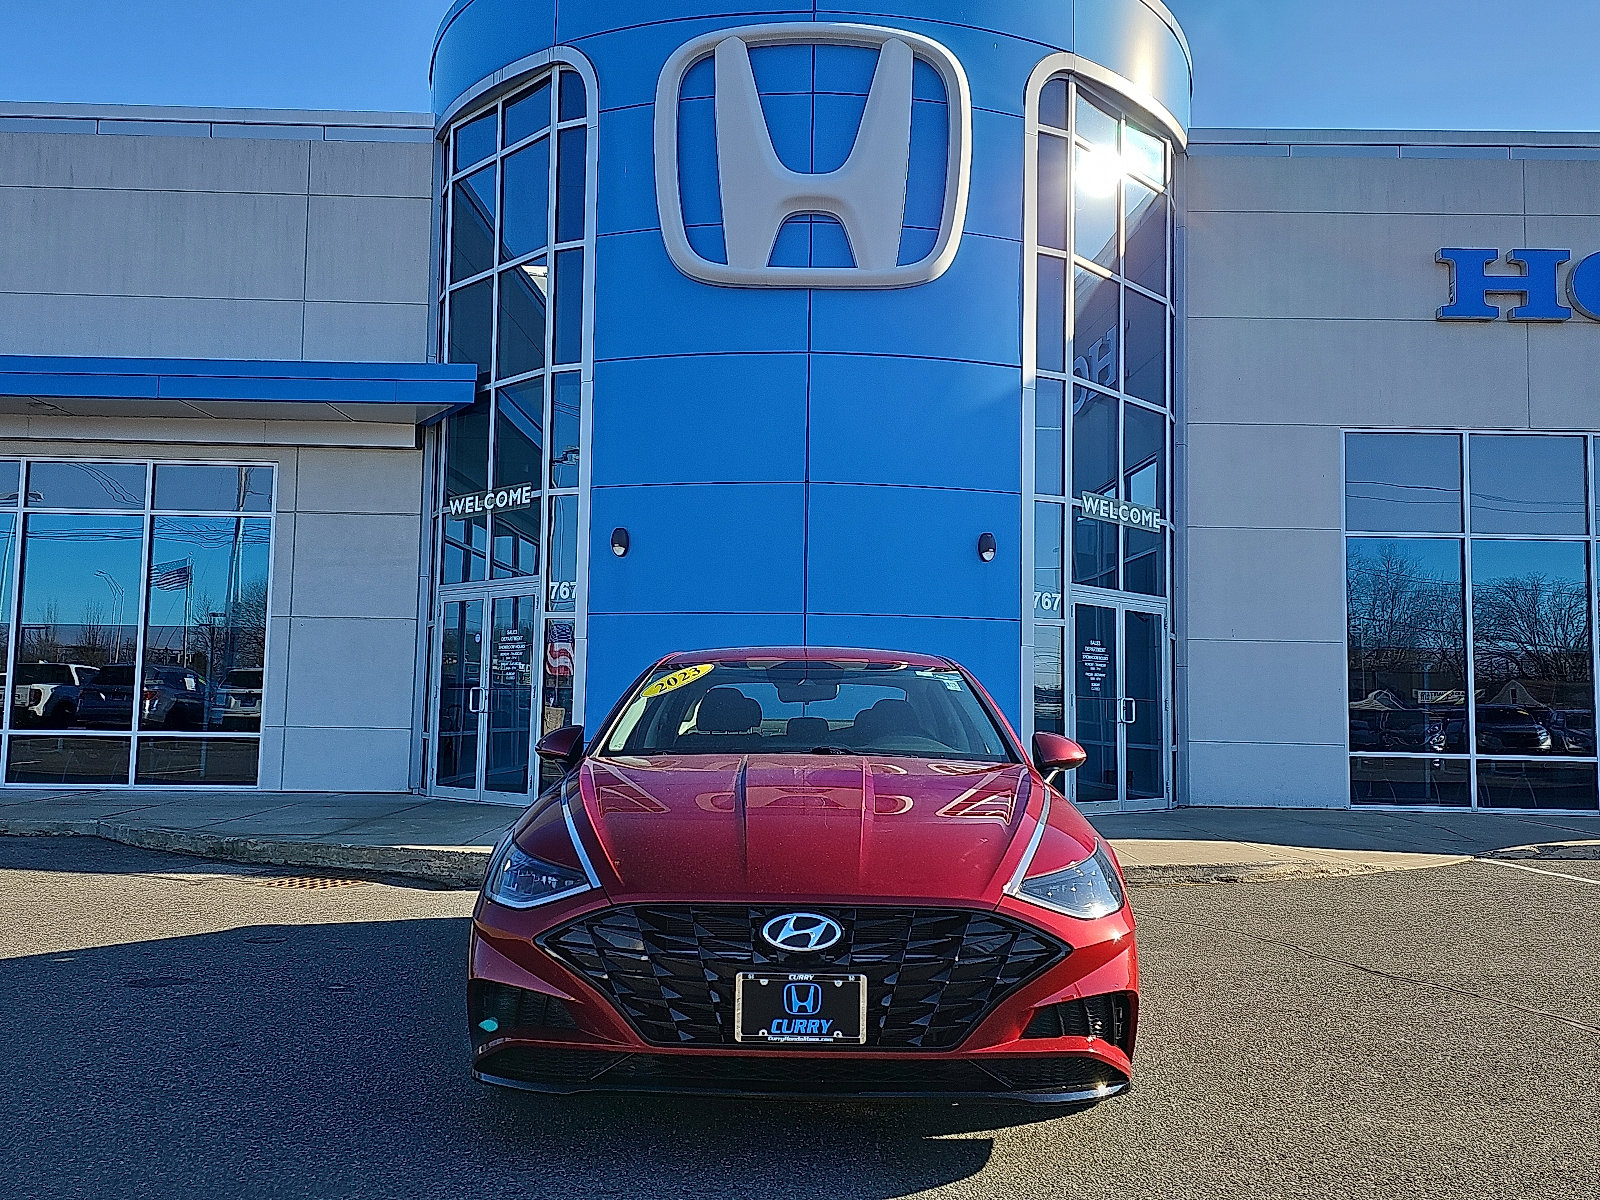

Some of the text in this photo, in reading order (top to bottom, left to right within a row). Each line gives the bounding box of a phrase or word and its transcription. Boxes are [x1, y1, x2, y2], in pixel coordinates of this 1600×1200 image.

[449, 486, 532, 516] WELCOME
[1082, 495, 1161, 530] WELCOME
[549, 581, 578, 600] 767
[1033, 591, 1062, 611] 767
[654, 667, 701, 693] 2023
[770, 1018, 834, 1035] CURRY
